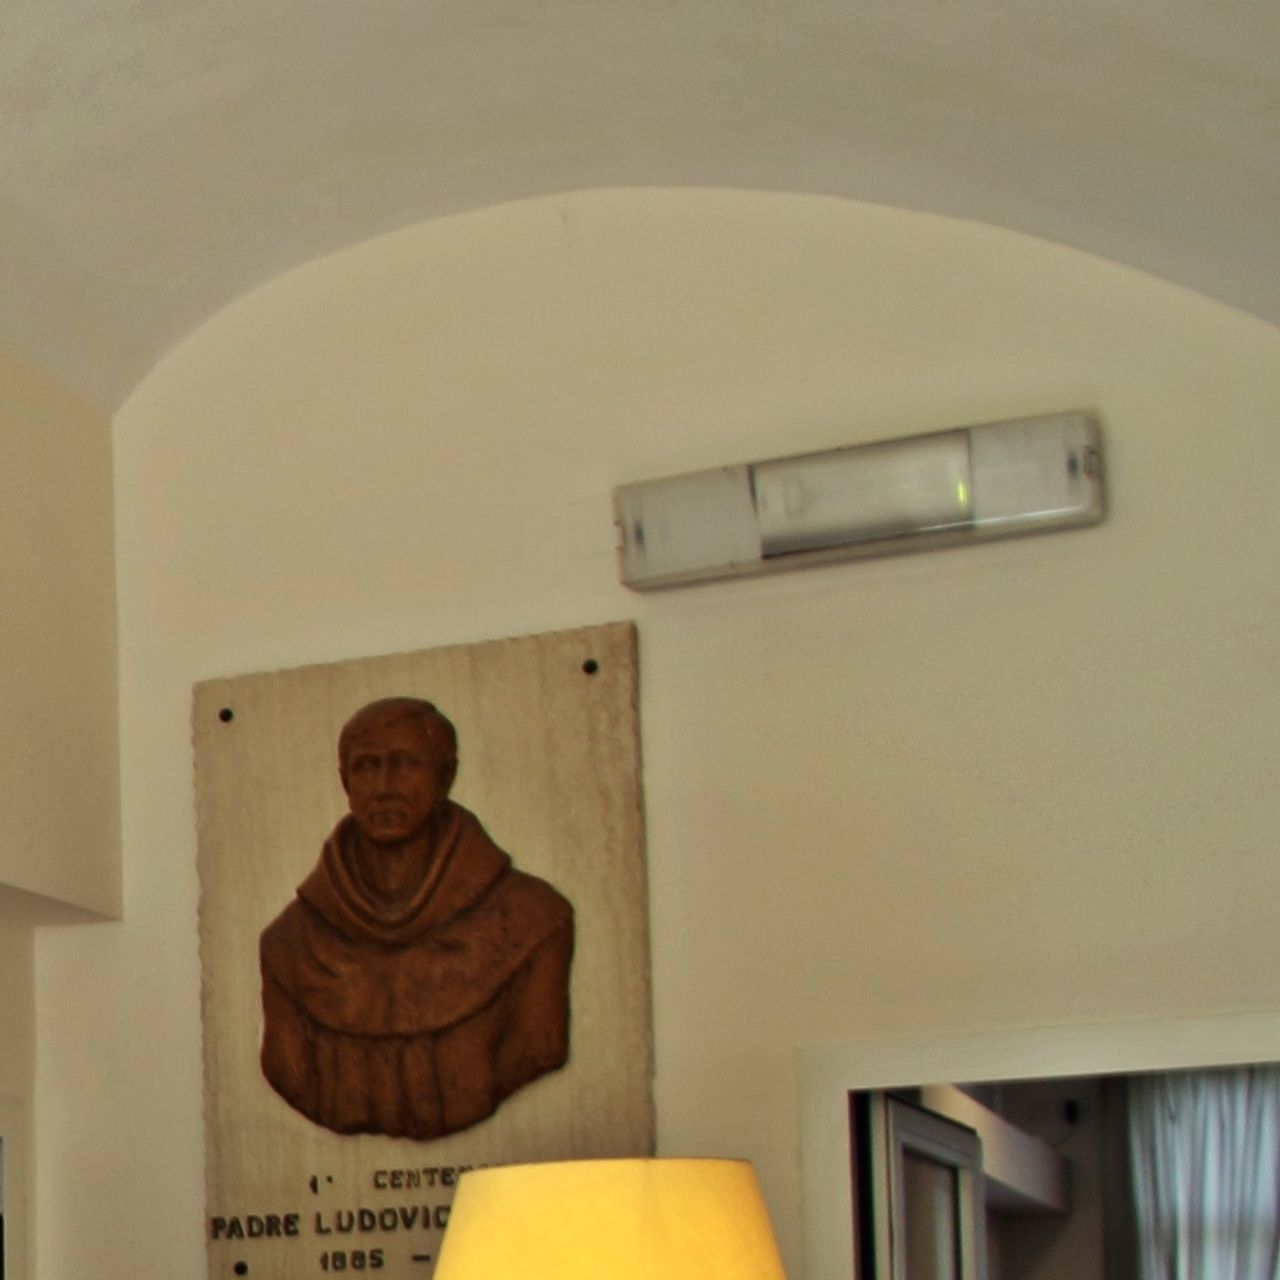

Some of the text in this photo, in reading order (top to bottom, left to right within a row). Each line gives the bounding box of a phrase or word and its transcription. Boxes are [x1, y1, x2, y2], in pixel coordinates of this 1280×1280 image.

[372, 1164, 488, 1191] CENTE
[210, 1212, 300, 1240] PADRE
[319, 1247, 385, 1273] 1885
